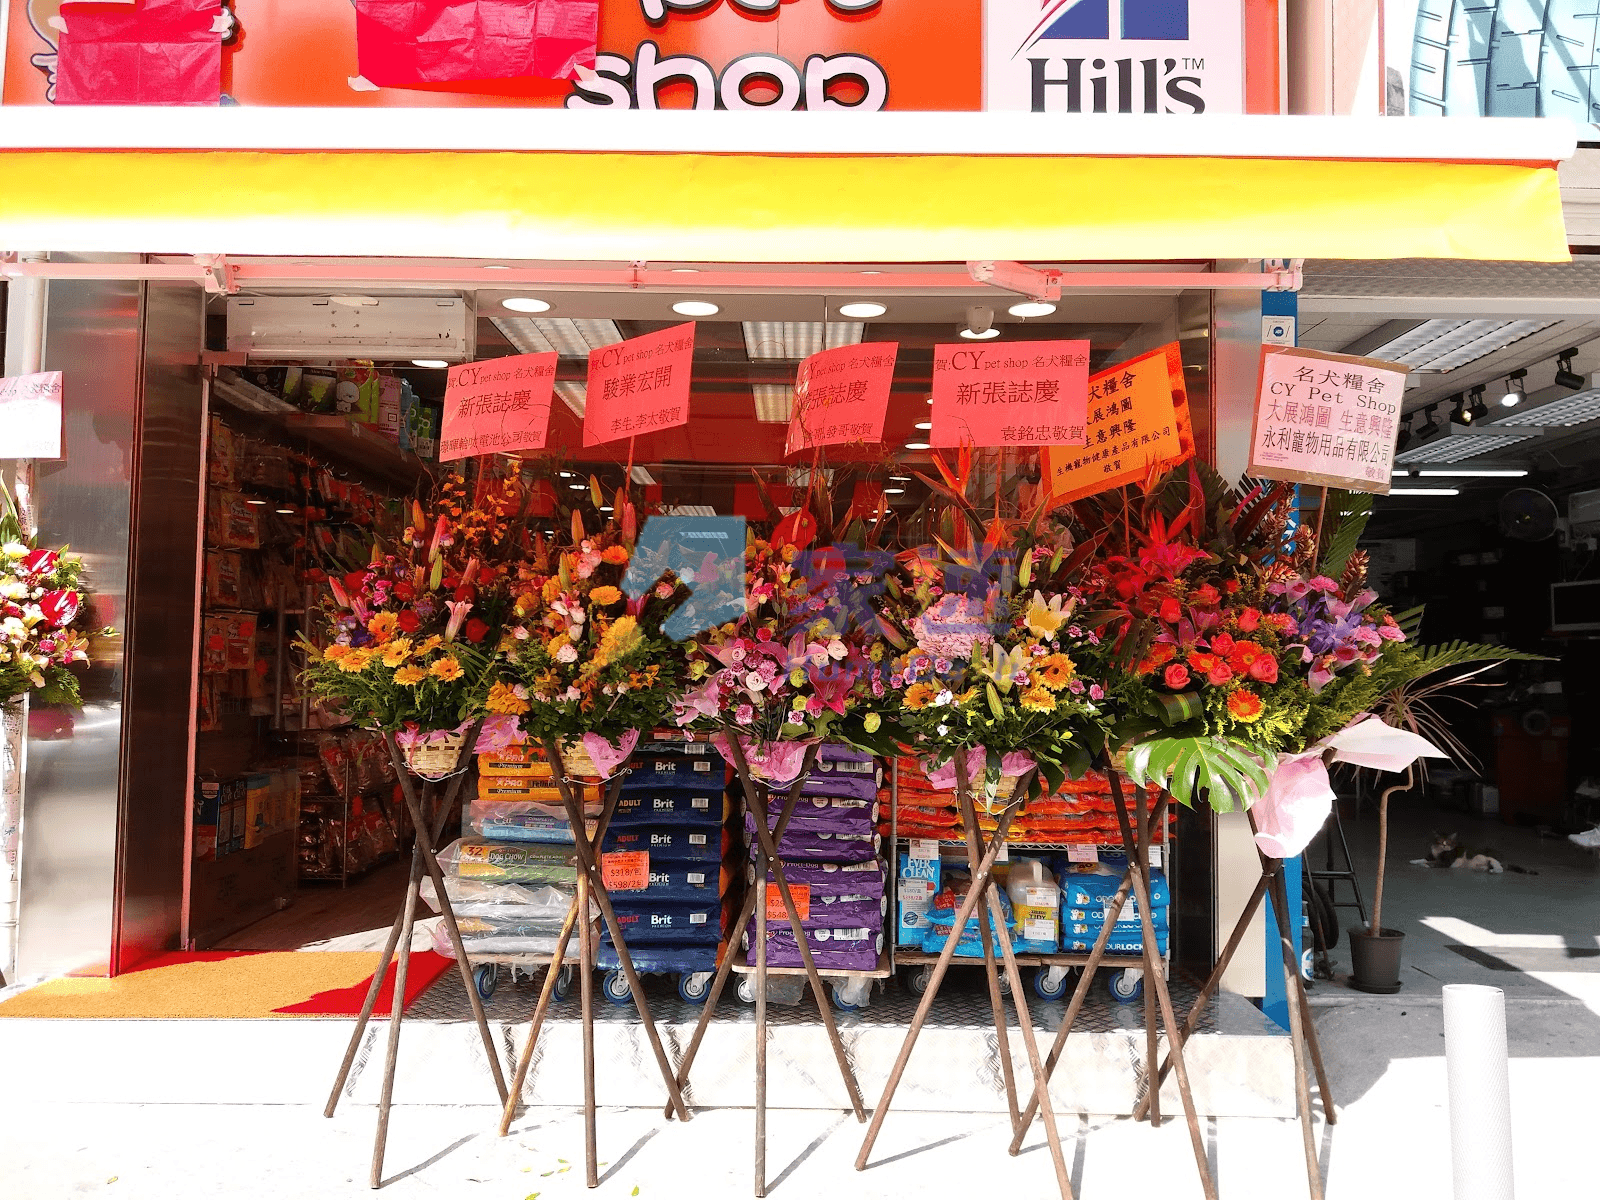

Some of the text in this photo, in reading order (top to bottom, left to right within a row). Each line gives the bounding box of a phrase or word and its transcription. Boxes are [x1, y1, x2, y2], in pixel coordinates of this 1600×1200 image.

[565, 40, 889, 113] shop
[1028, 57, 1206, 115] Hill's
[984, 359, 1001, 371] pet
[1003, 357, 1029, 370] shop
[1032, 353, 1088, 368] 名犬糧舍
[602, 364, 673, 400] 駿業宏開
[1293, 366, 1385, 395] 名犬糧舍
[804, 380, 869, 411] 張誌慶
[956, 379, 1060, 405] 新張誌慶
[1270, 382, 1396, 415] CY Pet Shop
[458, 389, 532, 419] 新張誌慶
[1265, 399, 1394, 440] 大展鴻圖 生意興隆
[1000, 425, 1084, 442] 袁銘忠敬賀
[1261, 425, 1391, 466] 永利寵物用品有限公司
[655, 761, 676, 771] Brit
[619, 799, 641, 807] ADULT
[653, 798, 674, 808] Brit
[650, 834, 672, 844] Brit
[467, 846, 483, 856] 32
[902, 867, 935, 878] CLEAN
[907, 859, 933, 869] EVER
[649, 873, 670, 882] Brit
[651, 914, 672, 924] Brit
